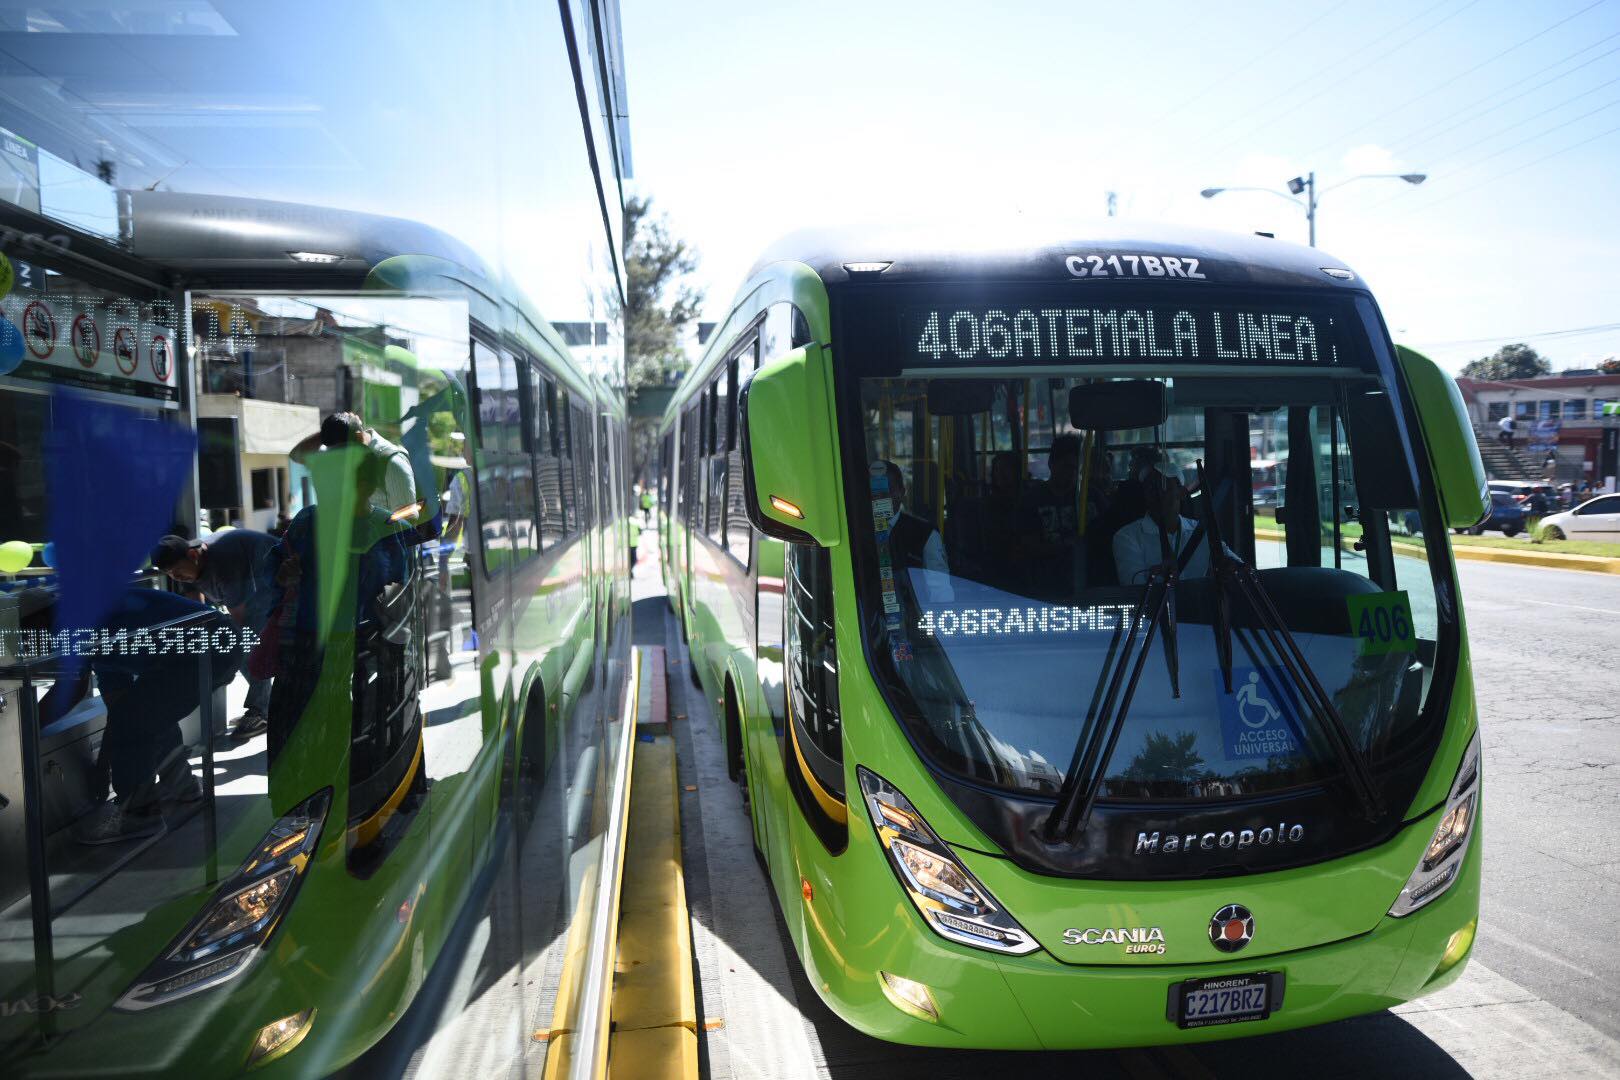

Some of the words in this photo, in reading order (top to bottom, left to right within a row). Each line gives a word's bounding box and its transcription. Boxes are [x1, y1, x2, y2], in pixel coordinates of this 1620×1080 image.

[1065, 255, 1206, 279] C217BRZ
[1213, 311, 1319, 362] LINEA
[1359, 604, 1409, 646] 406
[1240, 729, 1287, 743] ACCESO
[1233, 741, 1295, 756] UNIVERSAL
[1135, 822, 1304, 855] Marcopolo
[1063, 927, 1164, 945] SCANIA
[1204, 978, 1250, 990] HINORENT
